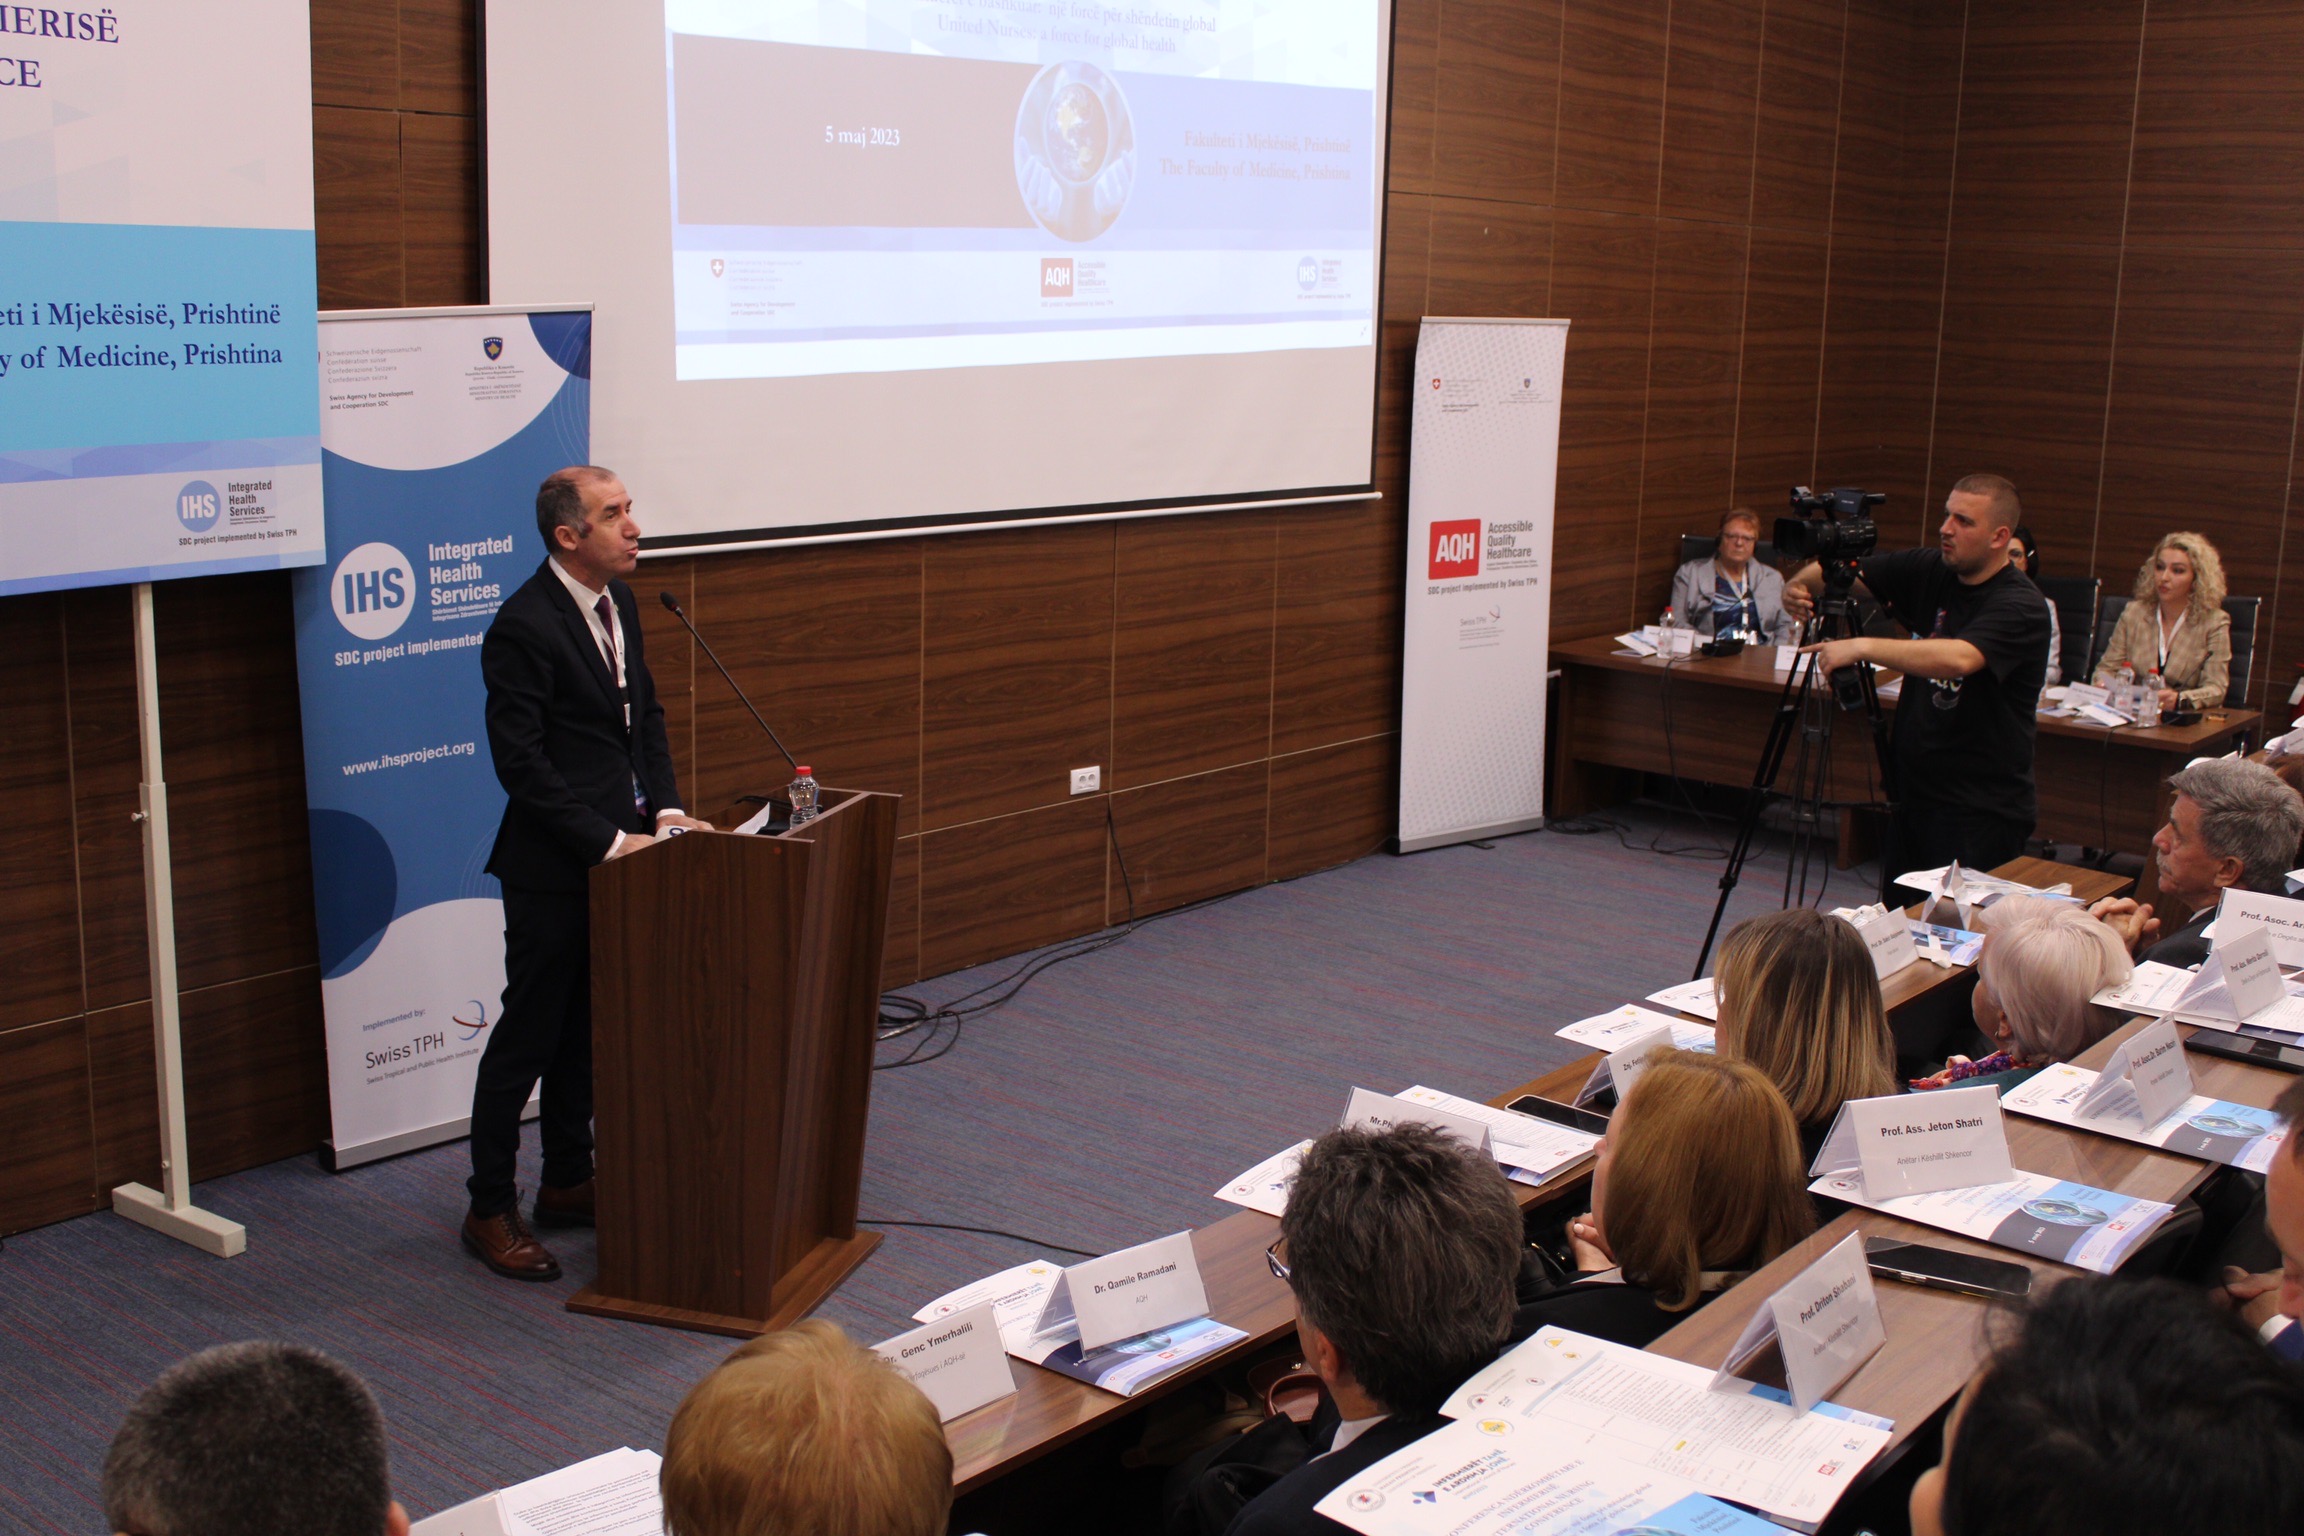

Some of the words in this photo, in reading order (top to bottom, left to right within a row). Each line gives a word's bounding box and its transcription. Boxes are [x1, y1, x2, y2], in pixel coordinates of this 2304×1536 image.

[937, 14, 983, 35] United
[1084, 29, 1100, 45] for
[1103, 34, 1138, 51] global
[1141, 37, 1176, 53] health
[1182, 16, 1216, 33] global
[825, 125, 834, 143] 5
[838, 127, 866, 149] maj
[870, 127, 900, 146] 2023
[1160, 157, 1184, 175] The
[1187, 160, 1230, 179] Faculty
[1233, 161, 1245, 176] of
[1045, 267, 1070, 287] AQH
[1299, 265, 1316, 282] IHS
[32, 303, 40, 325] i
[48, 303, 175, 332] Mjekësisë,
[182, 303, 281, 324] Prishtinë
[21, 346, 47, 369] of
[57, 344, 176, 371] Medicine,
[183, 343, 283, 365] Prishtina
[329, 394, 345, 402] Swiss
[346, 393, 367, 402] Agency
[378, 390, 414, 398] Development
[342, 401, 376, 410] Cooperation
[181, 494, 216, 519] IHS
[228, 480, 272, 493] Integrated
[229, 494, 257, 505] Health
[230, 506, 265, 516] Services
[179, 537, 192, 546] SDC
[194, 535, 216, 546] project
[218, 531, 257, 544] implemented
[258, 531, 265, 540] by
[267, 530, 283, 538] Swiss
[1434, 533, 1475, 564] AQH
[1488, 521, 1533, 533] Accessible
[1487, 535, 1516, 547] Quality
[1487, 547, 1532, 560] Healthcare
[343, 567, 406, 614] IHS
[428, 535, 513, 562] Integrated
[429, 562, 482, 585] Health
[431, 584, 500, 606] Services
[1428, 586, 1440, 595] SDC
[1441, 585, 1461, 596] project
[1462, 581, 1499, 592] implemented
[1500, 580, 1506, 589] by
[1508, 578, 1524, 587] Swiss
[1526, 577, 1538, 586] TPH
[335, 650, 360, 667] SDC
[363, 642, 404, 665] project
[407, 631, 483, 655] implemented
[342, 742, 475, 776] www.ihsproject.org
[2240, 910, 2261, 921] Prof.
[2263, 915, 2290, 926] Asoc.
[362, 1010, 413, 1032] Implemented
[414, 1008, 426, 1018] by:
[365, 1045, 411, 1069] Swiss
[413, 1032, 445, 1054] TPH
[1881, 1126, 1904, 1137] Prof.
[1905, 1125, 1925, 1135] Ass.
[1928, 1121, 1954, 1132] Jeton
[1955, 1117, 1983, 1129] Shatri
[1945, 1149, 1973, 1160] Shkencor
[1094, 1284, 1106, 1294] Dr.
[1107, 1275, 1136, 1290] Qamile
[1137, 1261, 1177, 1282] Ramadani
[1136, 1294, 1148, 1304] AQH
[1800, 1305, 1816, 1324] Prof.
[1814, 1292, 1834, 1313] Driton
[1832, 1272, 1857, 1298] Shabani
[901, 1343, 926, 1359] Genc
[926, 1321, 974, 1348] Ymerhalili
[1445, 1499, 1505, 1536] ONFERENCA
[1493, 1495, 1557, 1536] TERNATIONAL
[1523, 1496, 1585, 1532] CONFERENCE
